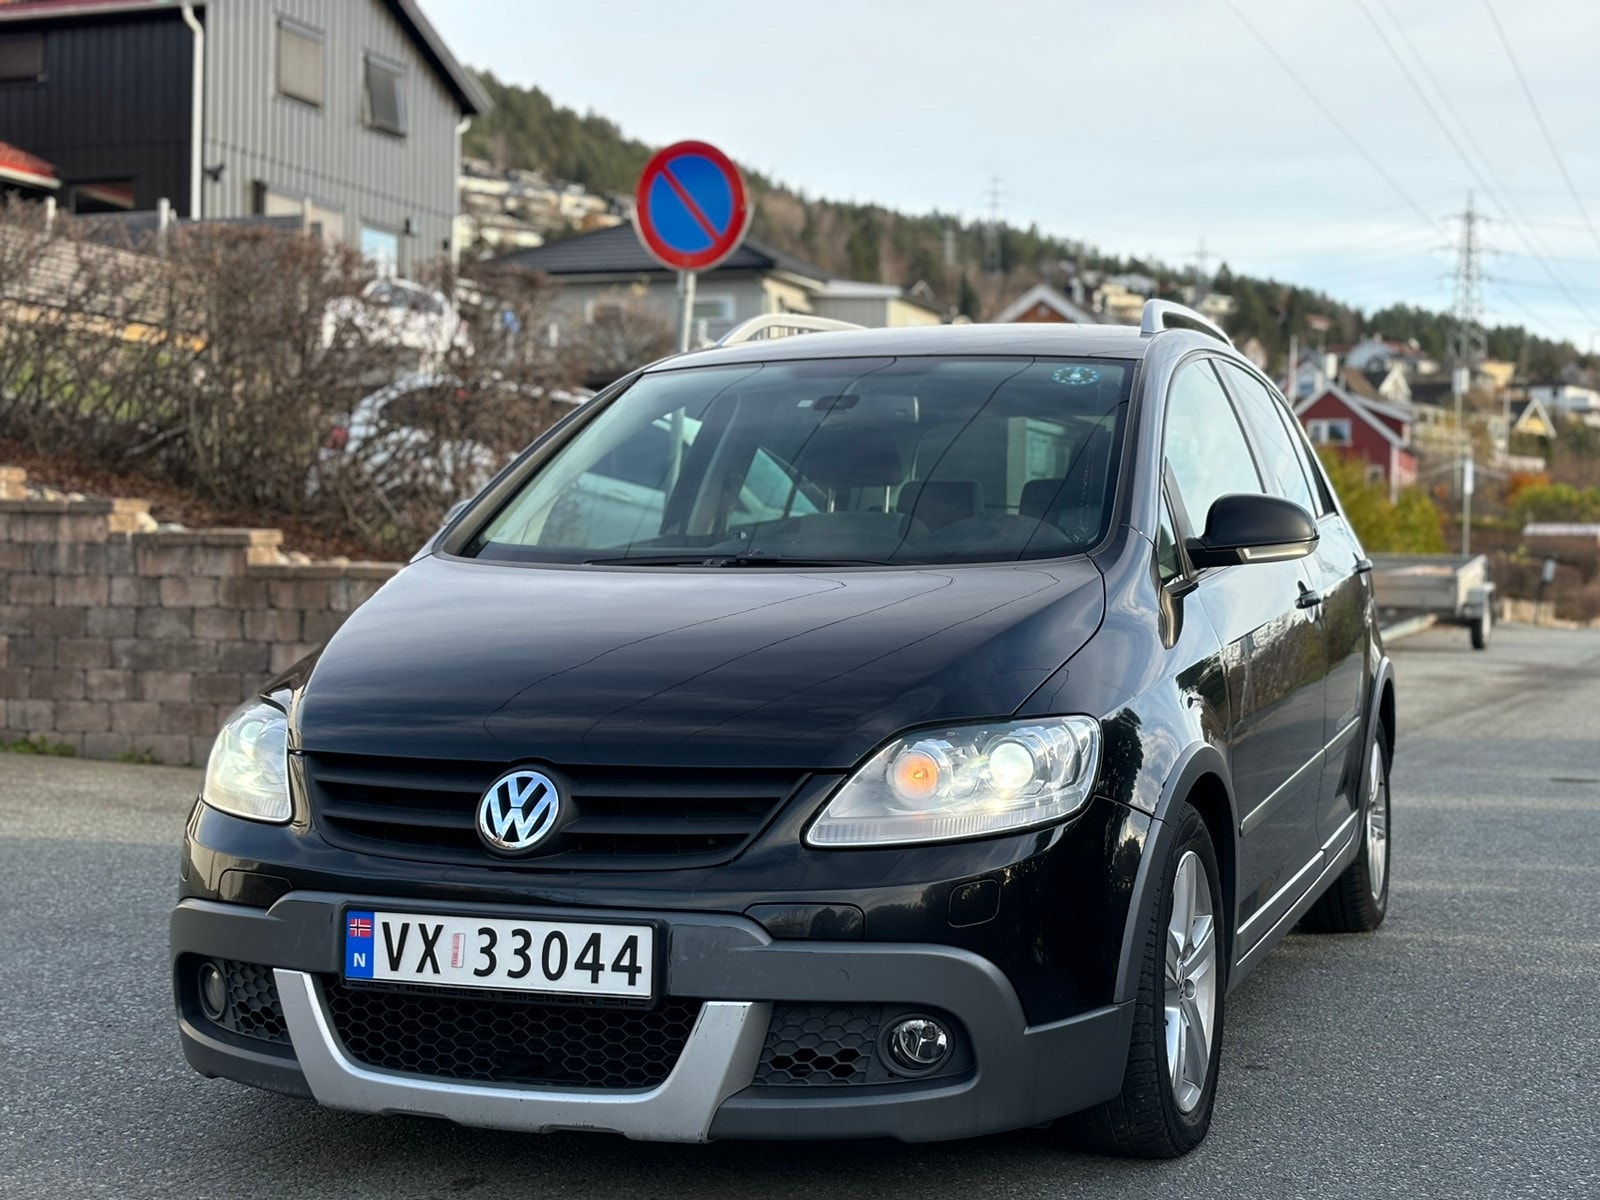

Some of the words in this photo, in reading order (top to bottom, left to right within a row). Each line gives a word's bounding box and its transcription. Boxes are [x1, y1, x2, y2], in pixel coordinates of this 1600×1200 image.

[481, 772, 557, 848] VW
[353, 952, 366, 968] N
[381, 921, 444, 975] VX
[473, 927, 642, 986] 33044
